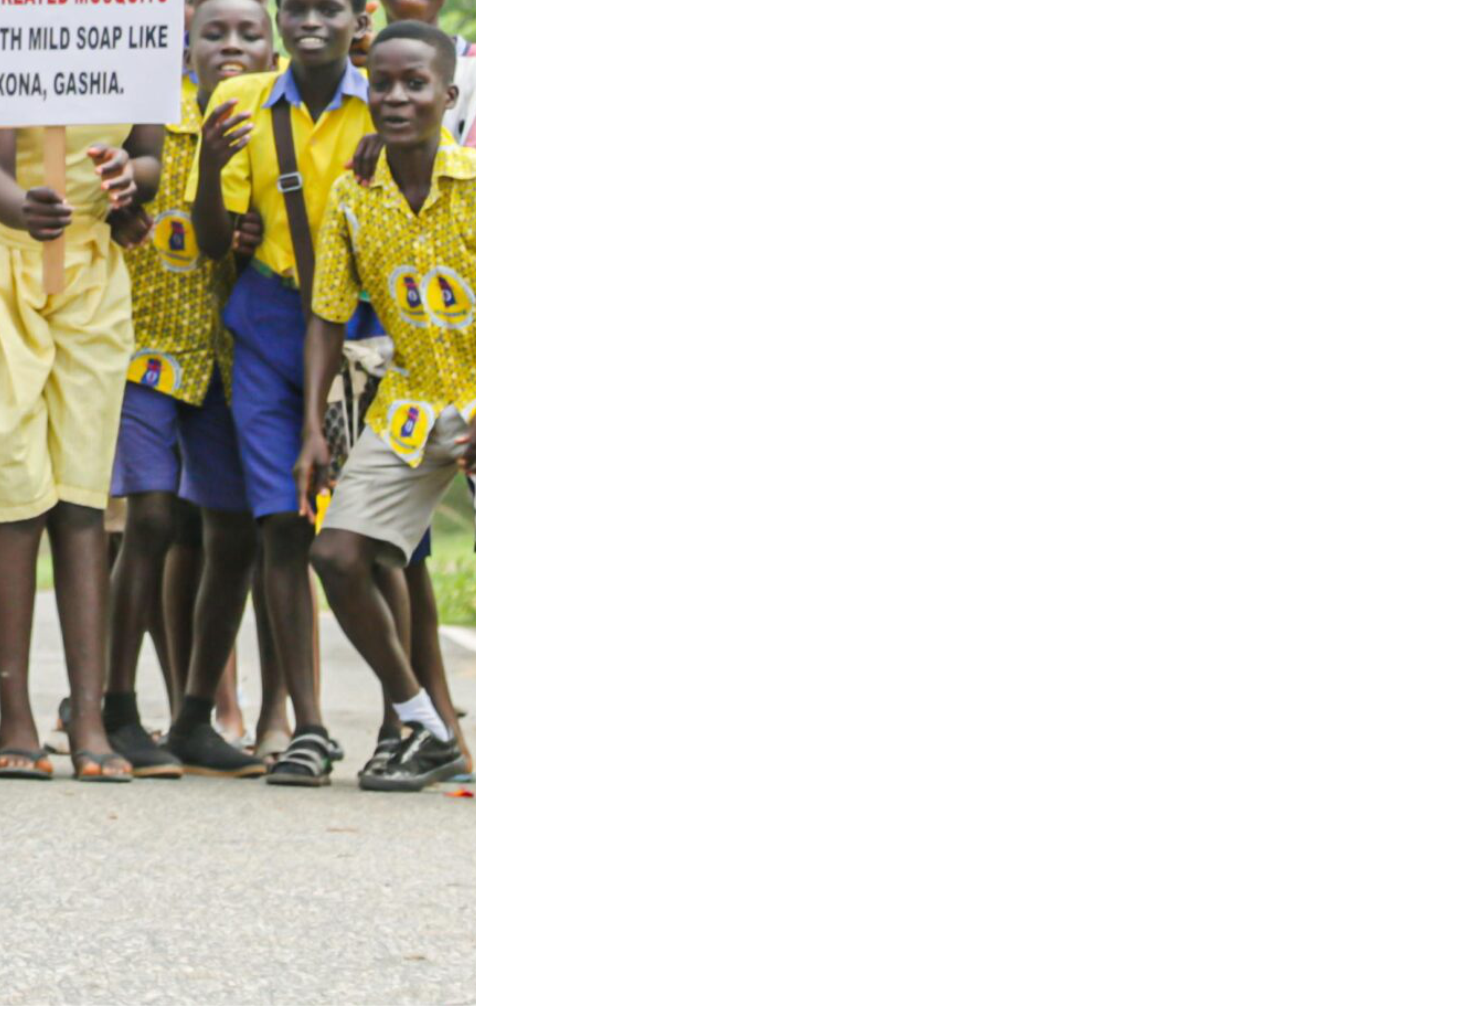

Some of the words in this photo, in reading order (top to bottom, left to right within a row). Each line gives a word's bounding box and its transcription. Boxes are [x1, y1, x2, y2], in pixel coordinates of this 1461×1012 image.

[28, 26, 71, 51] MILD
[76, 25, 123, 51] SOAP
[128, 24, 169, 50] LIKE
[53, 71, 125, 96] GASHIA.
